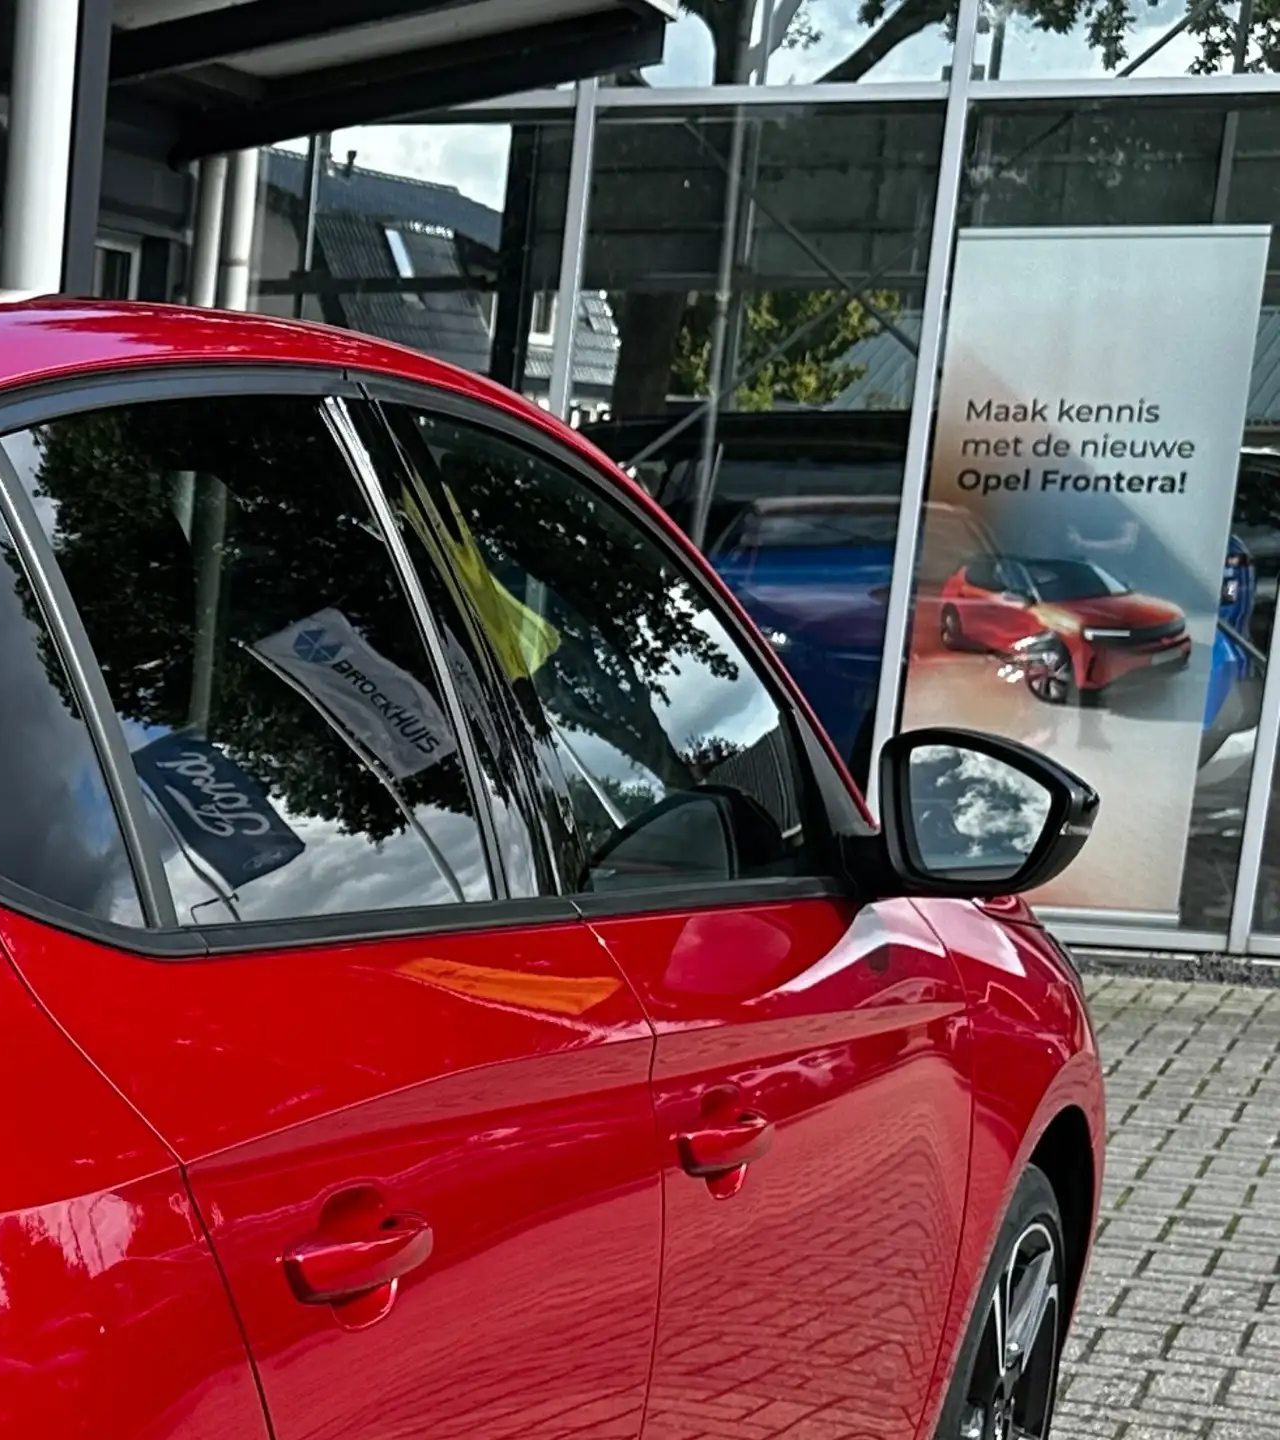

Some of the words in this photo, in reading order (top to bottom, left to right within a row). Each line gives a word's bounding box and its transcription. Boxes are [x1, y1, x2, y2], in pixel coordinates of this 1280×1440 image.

[966, 399, 1048, 424] Maak
[1057, 399, 1160, 424] kennis
[961, 434, 1021, 458] met
[1032, 433, 1070, 458] de
[1080, 433, 1195, 459] nieuwe
[957, 469, 1030, 495] Opel
[1040, 470, 1188, 495] Frontera!
[156, 752, 270, 837] Ford
